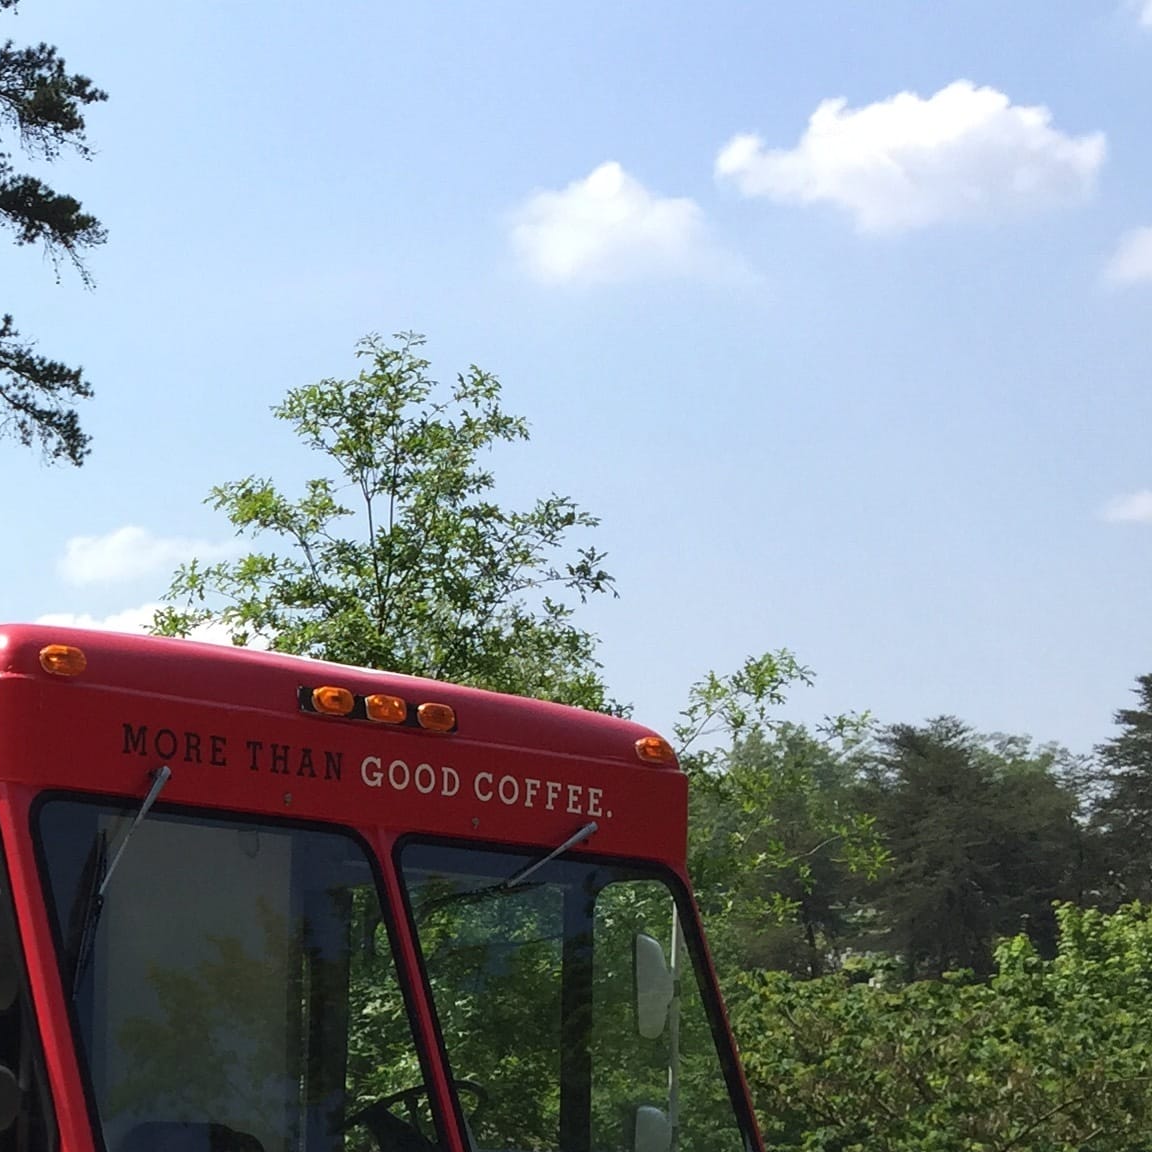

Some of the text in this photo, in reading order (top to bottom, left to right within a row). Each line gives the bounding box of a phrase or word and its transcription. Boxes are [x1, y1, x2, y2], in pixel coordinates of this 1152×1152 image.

[122, 723, 613, 818] MORE THAN GOOD COFFEE.
